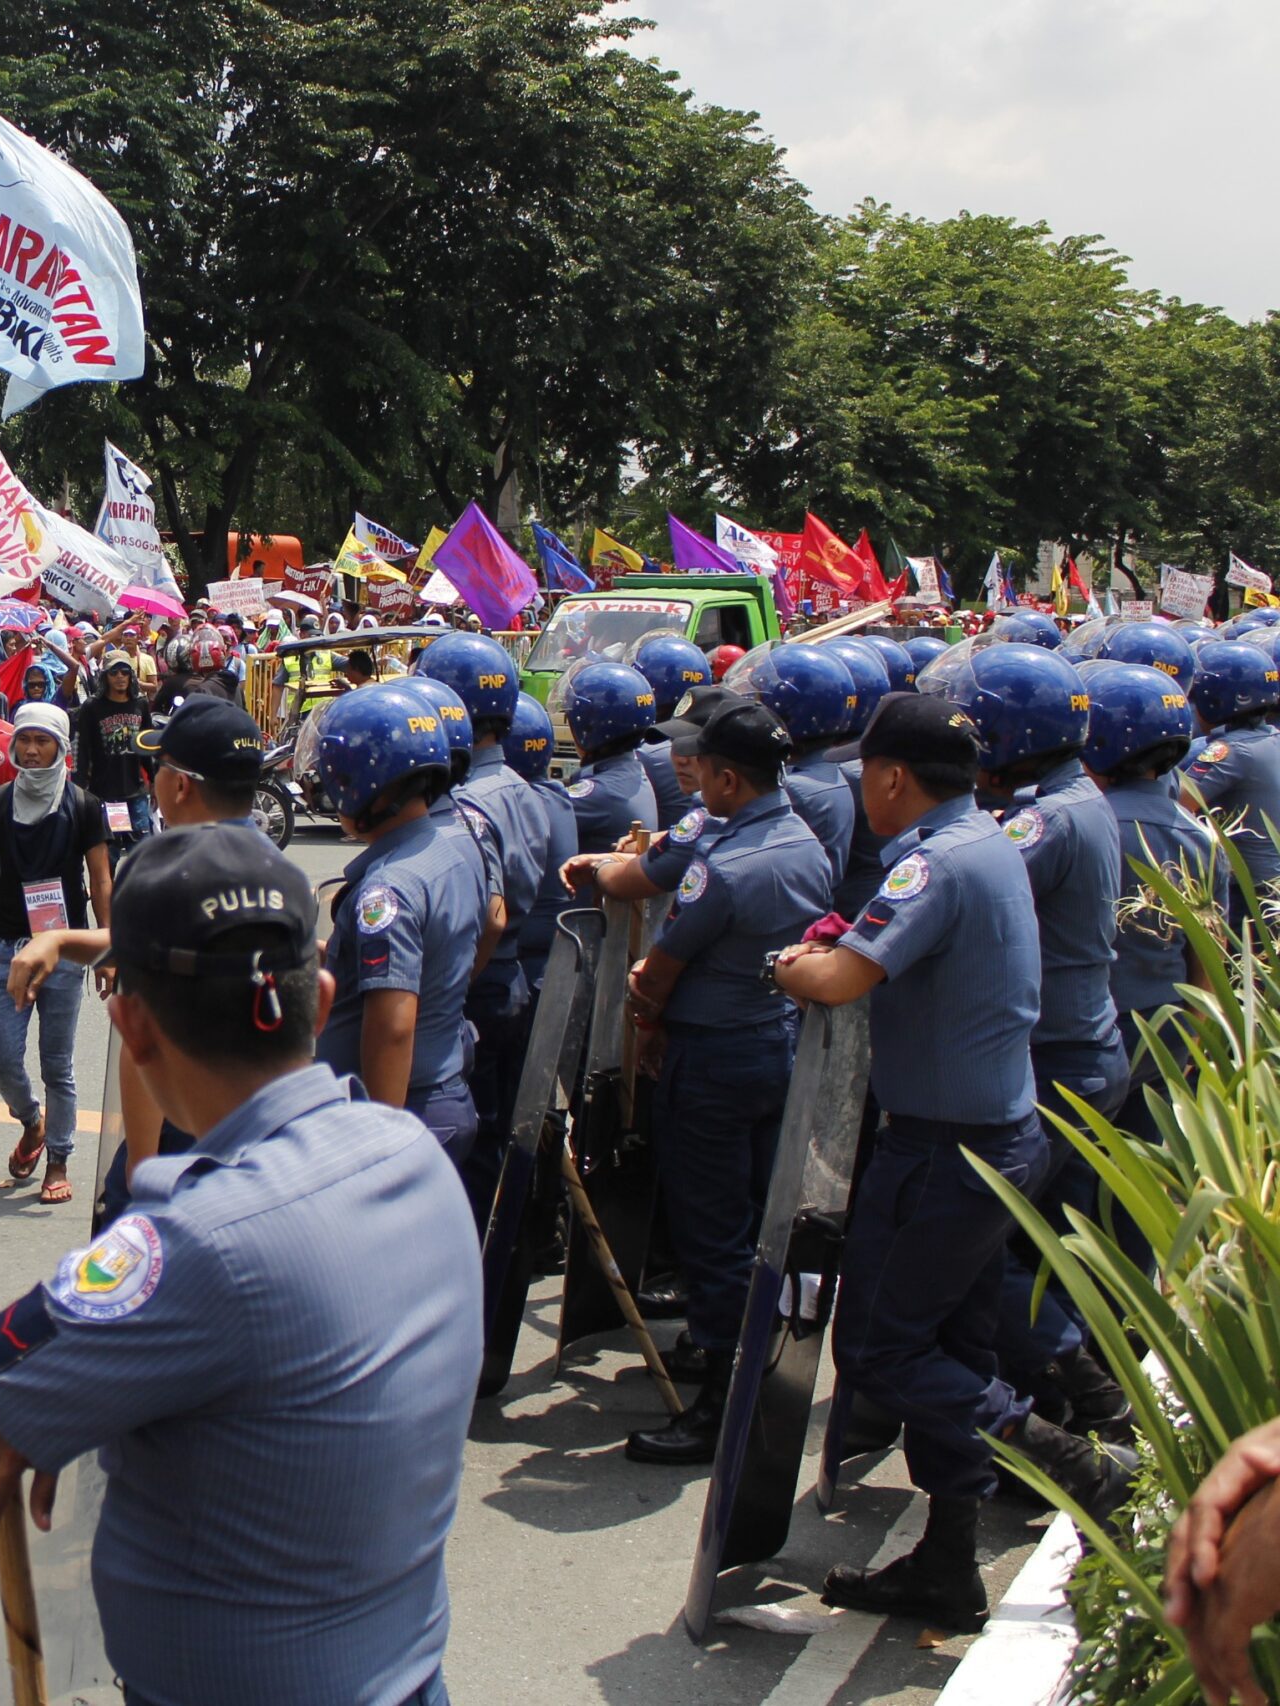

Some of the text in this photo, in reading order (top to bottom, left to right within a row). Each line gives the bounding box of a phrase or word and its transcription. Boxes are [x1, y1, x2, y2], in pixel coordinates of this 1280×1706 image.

[56, 545, 120, 597] APATAN
[42, 568, 76, 598] BIKOL
[682, 669, 704, 683] PNP
[1153, 661, 1179, 678] PNP
[479, 674, 507, 689] PNP
[636, 693, 655, 708] PNP
[1162, 694, 1186, 709] PNP
[439, 705, 465, 722] PNP
[407, 716, 438, 734] PNP
[524, 738, 548, 753] PNP
[26, 888, 62, 905] MARSHALL
[199, 887, 285, 922] PULIS
